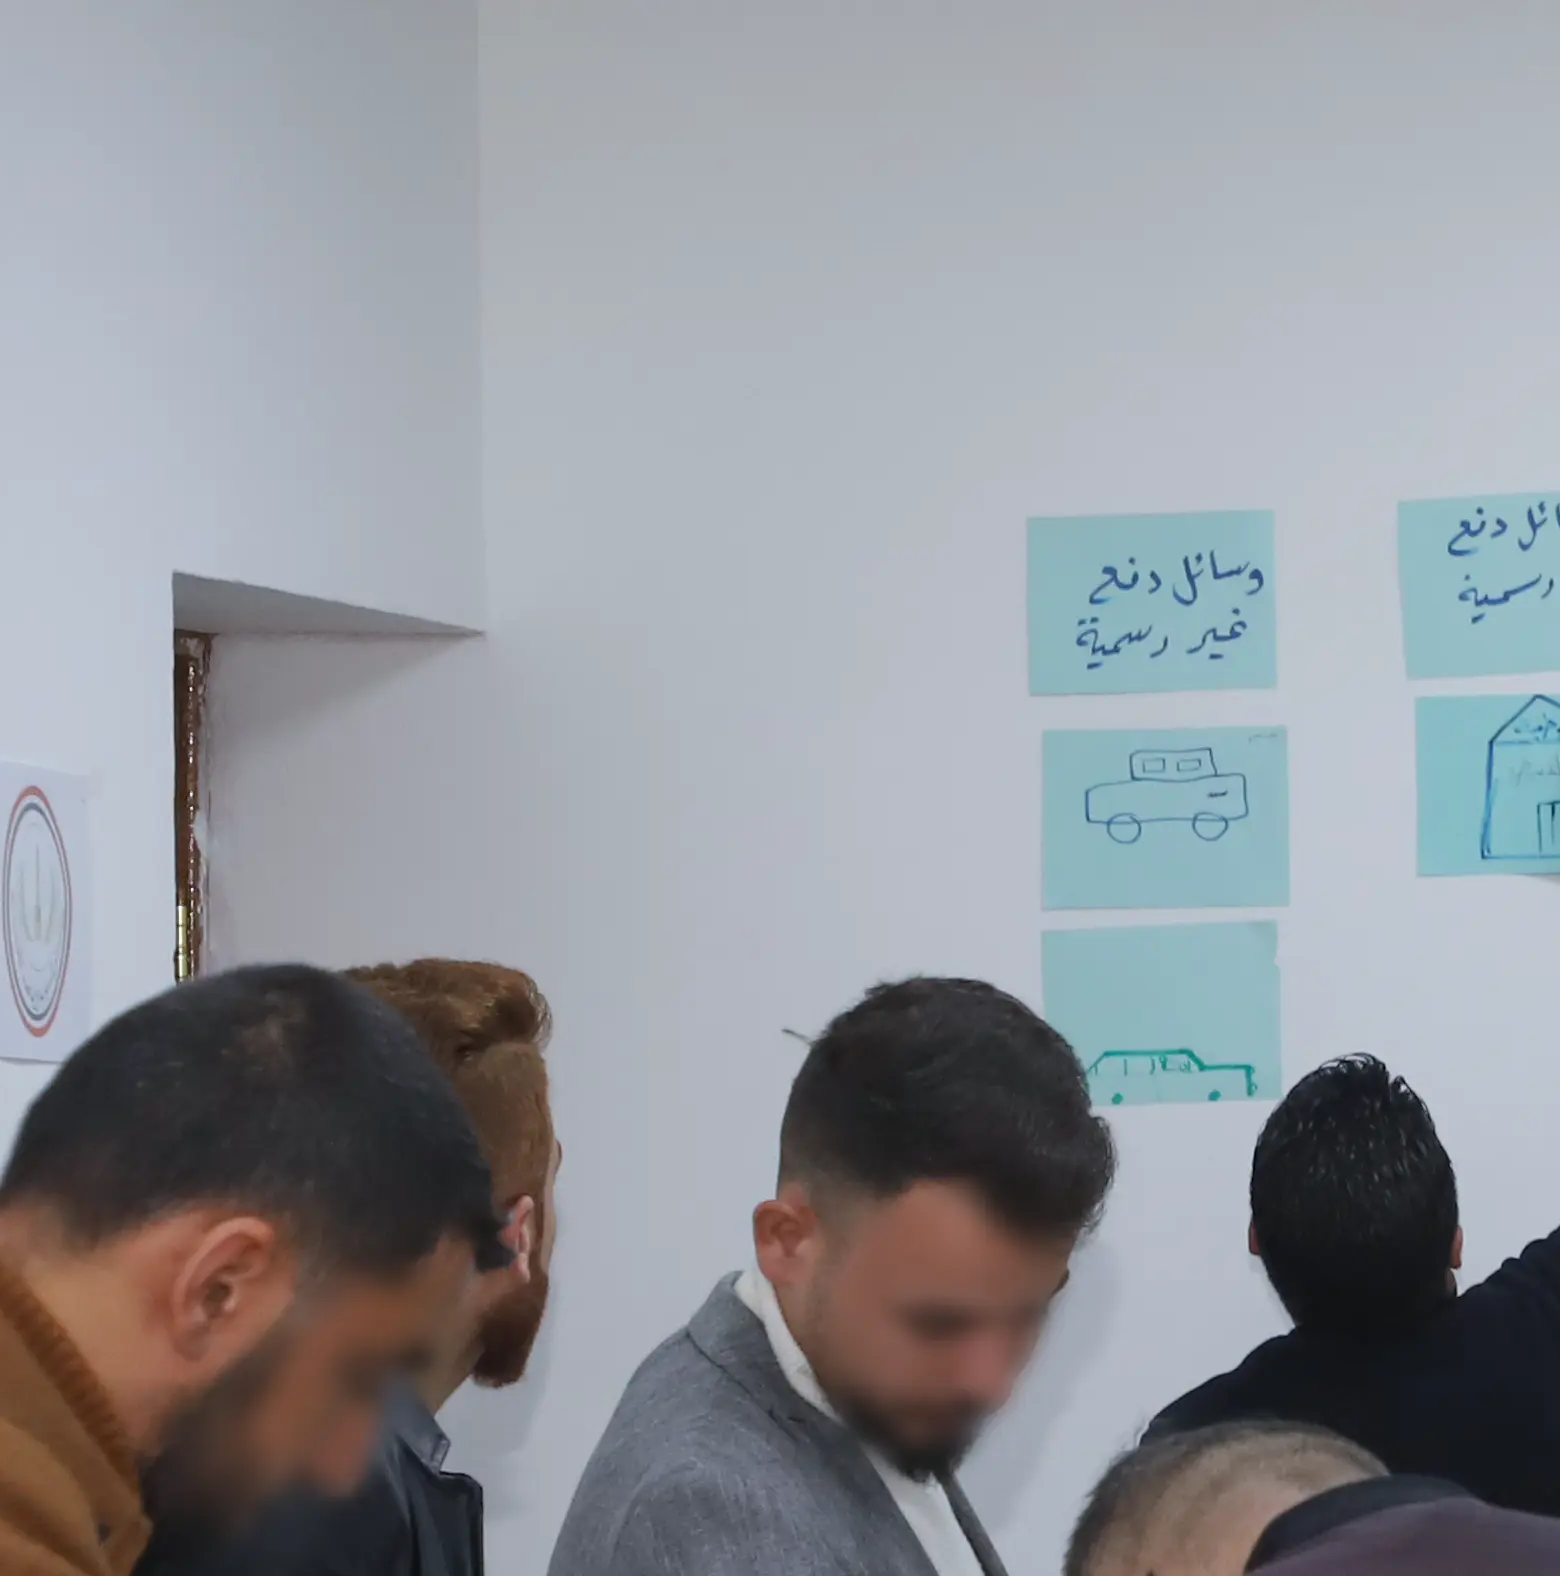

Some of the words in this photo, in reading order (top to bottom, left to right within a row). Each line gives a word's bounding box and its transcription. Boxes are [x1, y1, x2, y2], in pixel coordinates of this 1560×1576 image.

[1173, 549, 1264, 606] وسائل
[1458, 574, 1554, 624] رسمية
[1076, 617, 1168, 670] رسمية
[1186, 607, 1247, 660] غير
